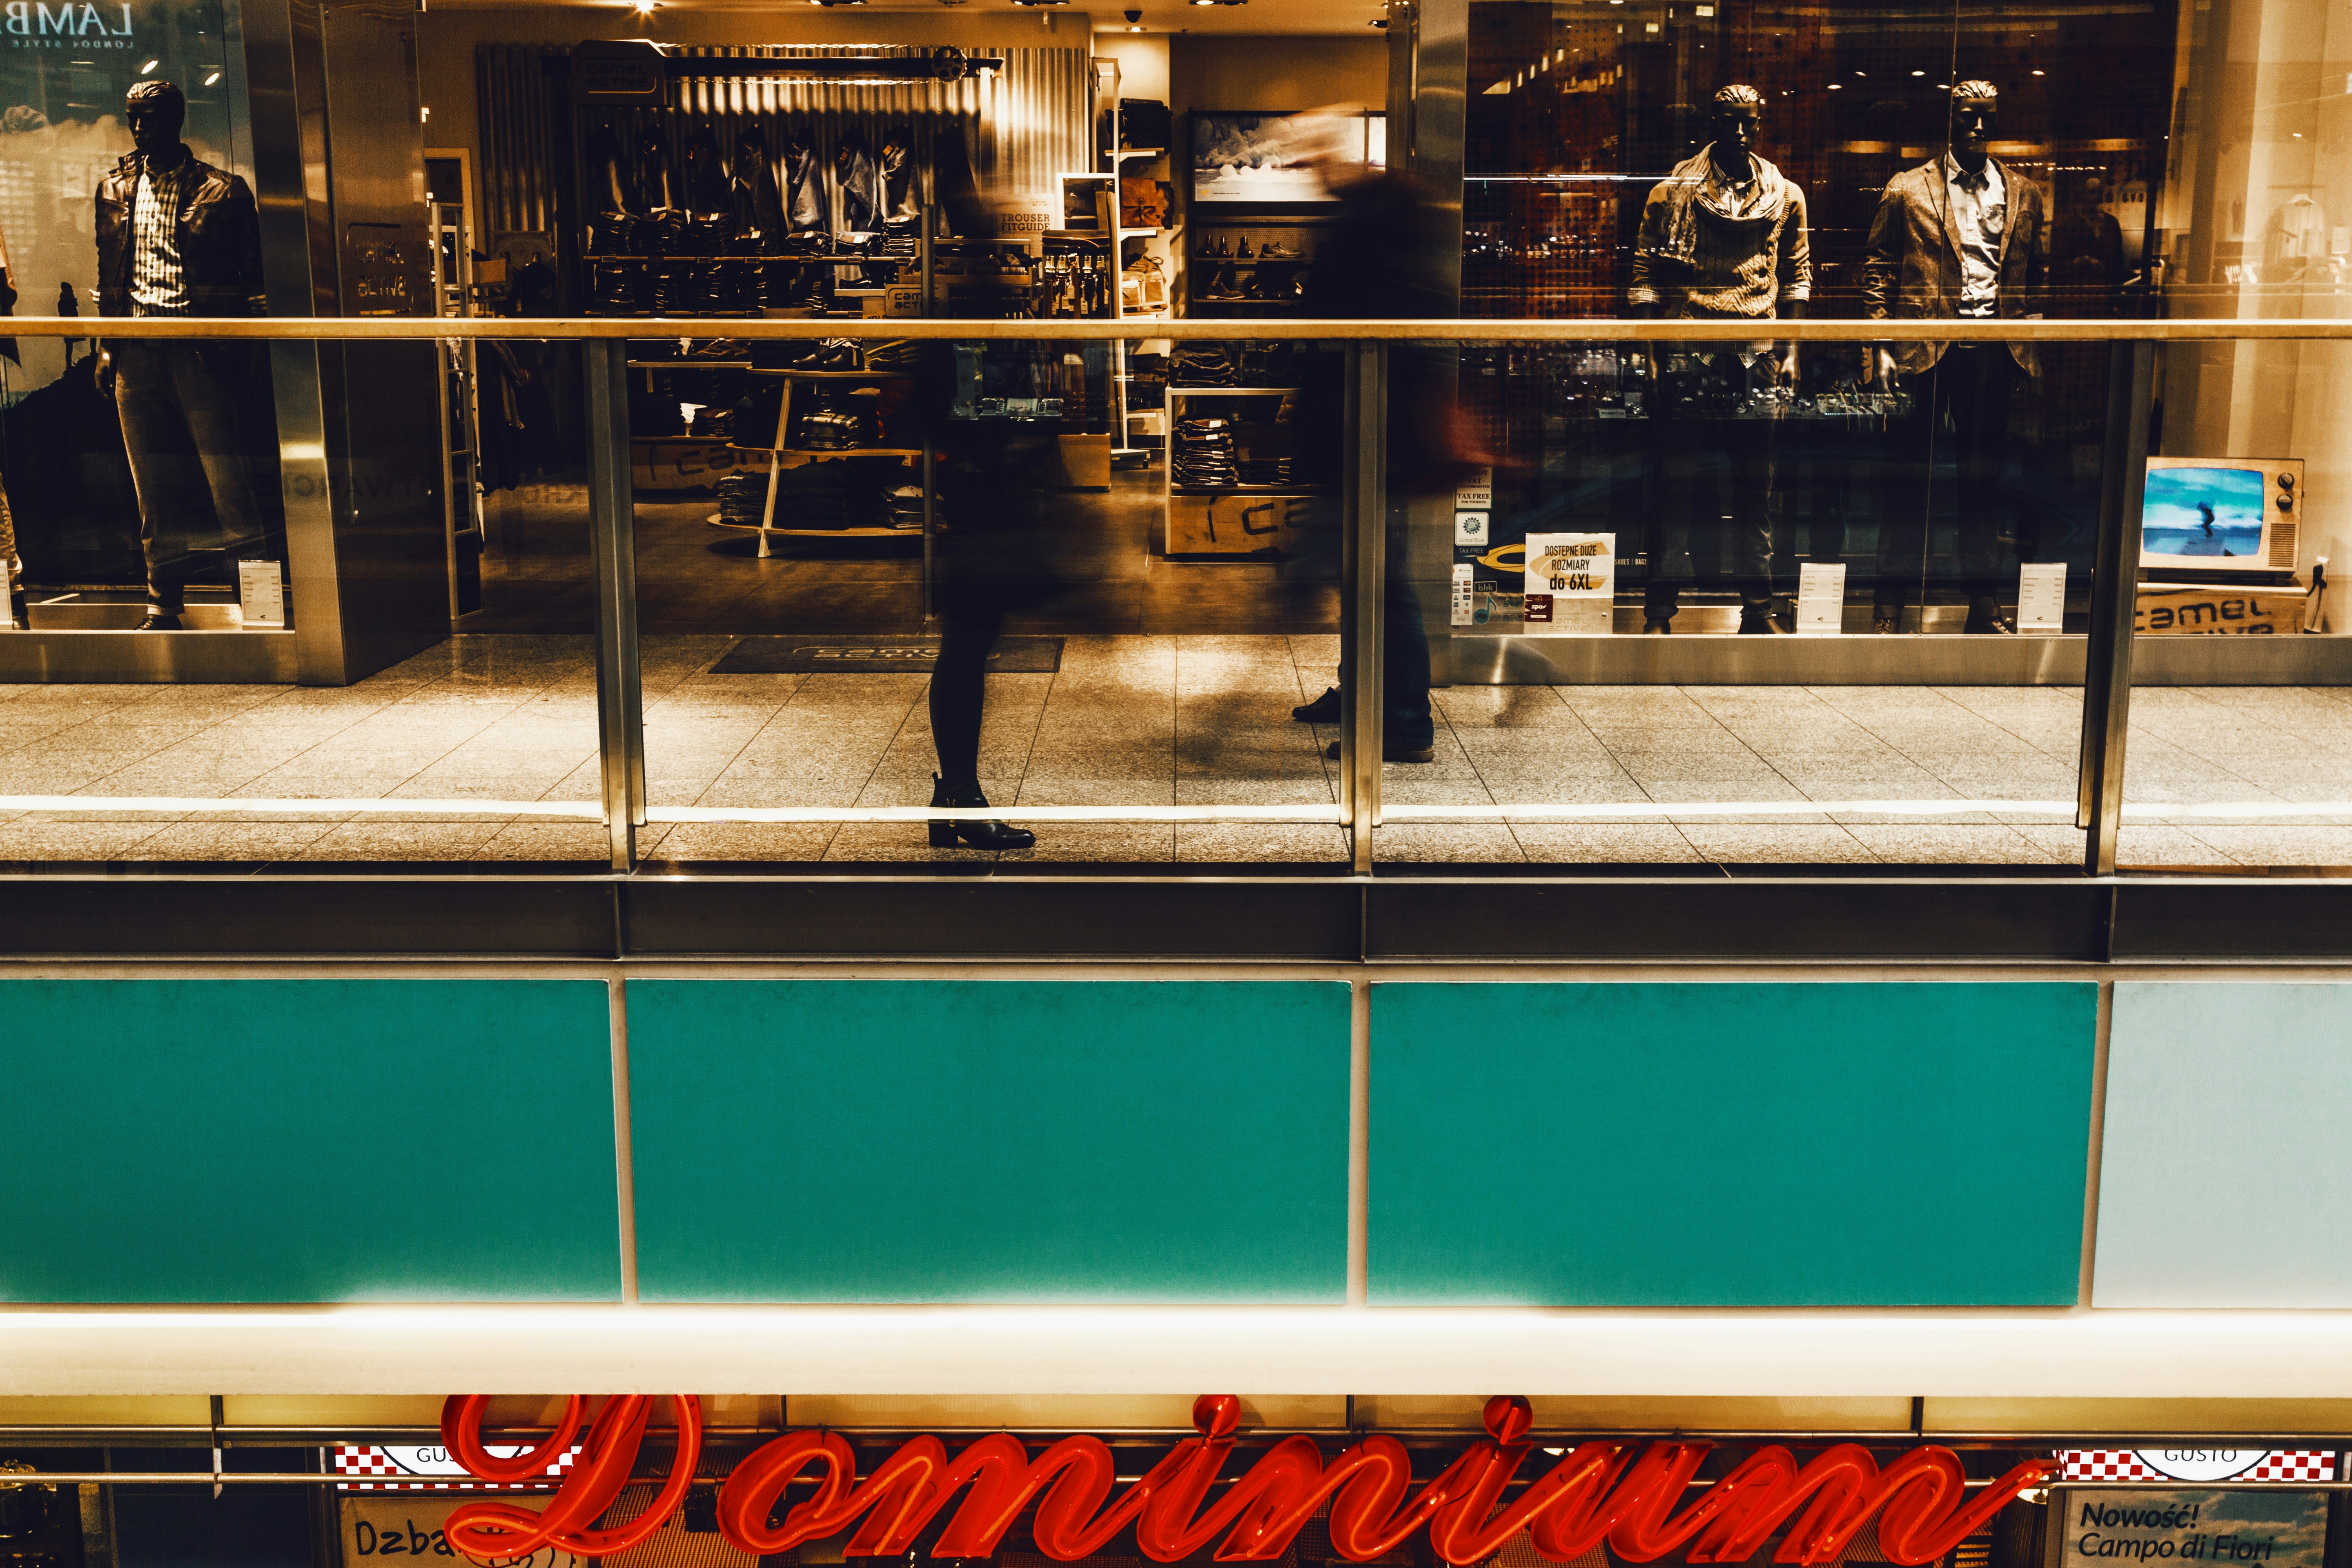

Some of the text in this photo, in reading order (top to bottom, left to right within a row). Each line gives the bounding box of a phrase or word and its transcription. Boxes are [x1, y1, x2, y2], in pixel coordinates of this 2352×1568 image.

[587, 65, 648, 74] camel
[588, 77, 648, 87] active
[1001, 223, 1050, 231] FITGUIDE
[1545, 544, 1597, 556] DOSTĘPNE DUŻE
[1552, 559, 1590, 570] ROZMIARY
[1550, 573, 1592, 590] do 6XL
[416, 1448, 454, 1462] GU
[2165, 1450, 2237, 1462] GUSTO
[441, 1394, 2063, 1566] Dominium
[2080, 1502, 2200, 1529] Nowość!
[355, 1519, 461, 1557] Dzba
[2078, 1532, 2274, 1563] Campo di Fiori
